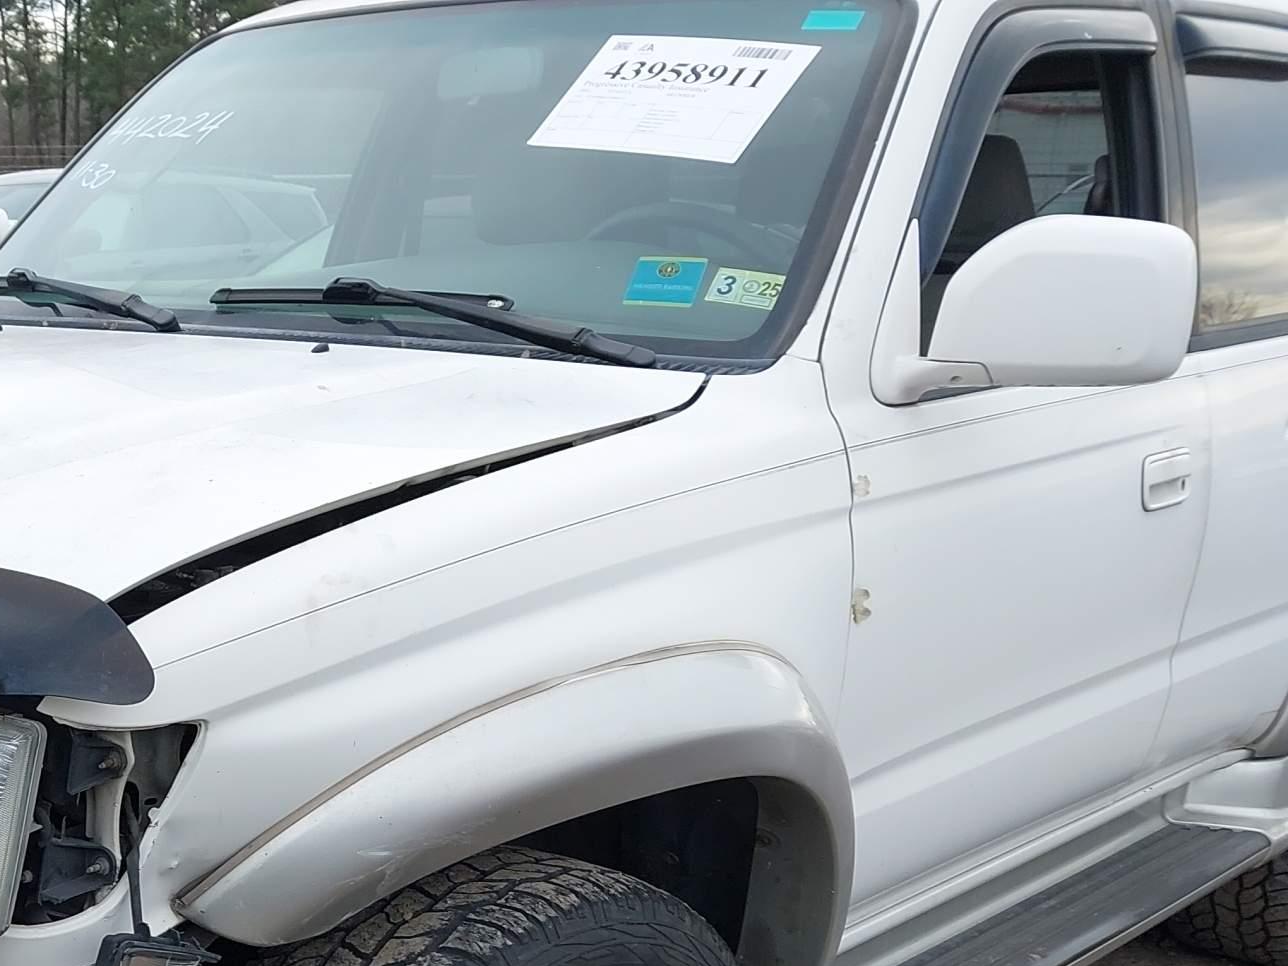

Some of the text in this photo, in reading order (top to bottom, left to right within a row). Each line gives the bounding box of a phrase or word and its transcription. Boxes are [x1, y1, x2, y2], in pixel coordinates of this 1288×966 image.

[604, 60, 768, 88] 43958911
[716, 275, 737, 296] 3
[758, 281, 783, 298] 25
